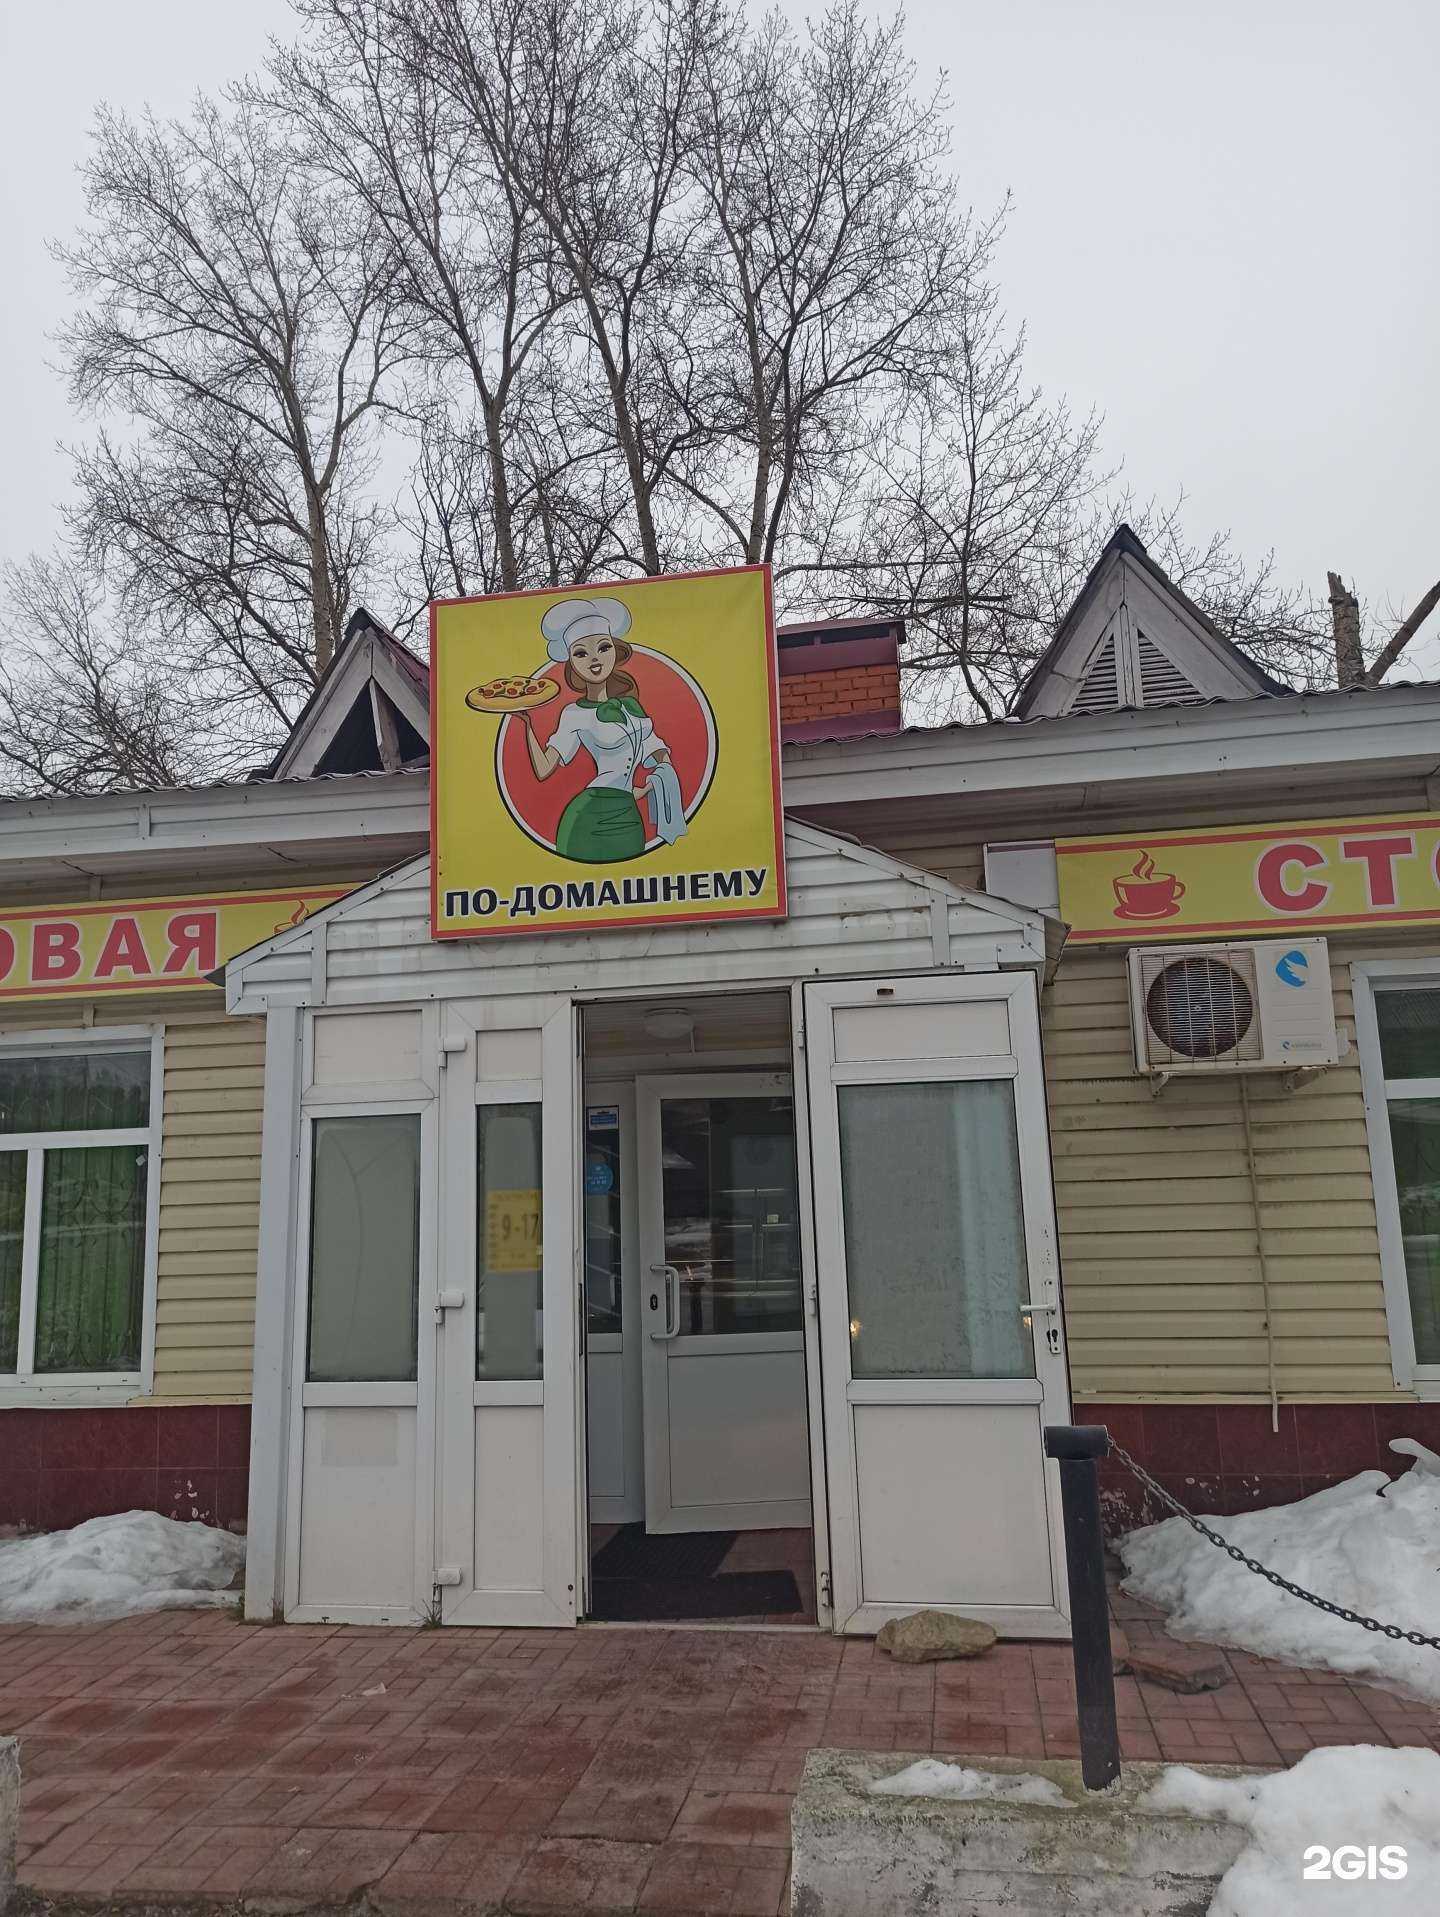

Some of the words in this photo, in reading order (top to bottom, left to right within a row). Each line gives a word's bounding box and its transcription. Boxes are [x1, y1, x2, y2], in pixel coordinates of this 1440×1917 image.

[445, 868, 768, 918] ПО-ДОМАШНЕМУ
[1257, 836, 1440, 912] СТ
[0, 912, 218, 984] ВАЯ
